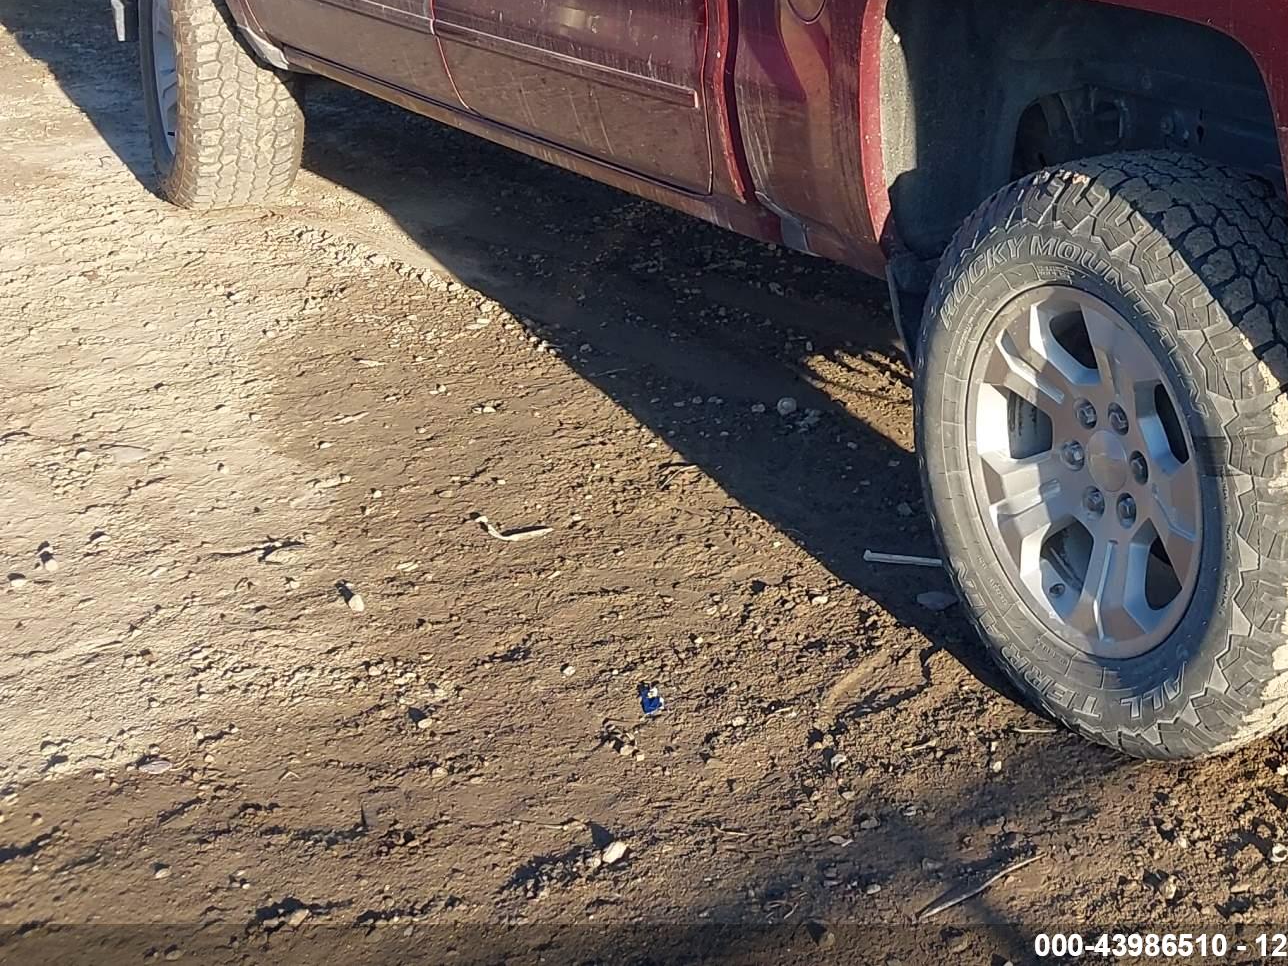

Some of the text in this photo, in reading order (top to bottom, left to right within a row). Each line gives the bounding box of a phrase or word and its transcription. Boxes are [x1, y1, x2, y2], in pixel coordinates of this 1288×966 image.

[939, 233, 1028, 332] ROCKY
[1029, 234, 1210, 419] MOUNTAIN
[1120, 659, 1188, 721] ALL
